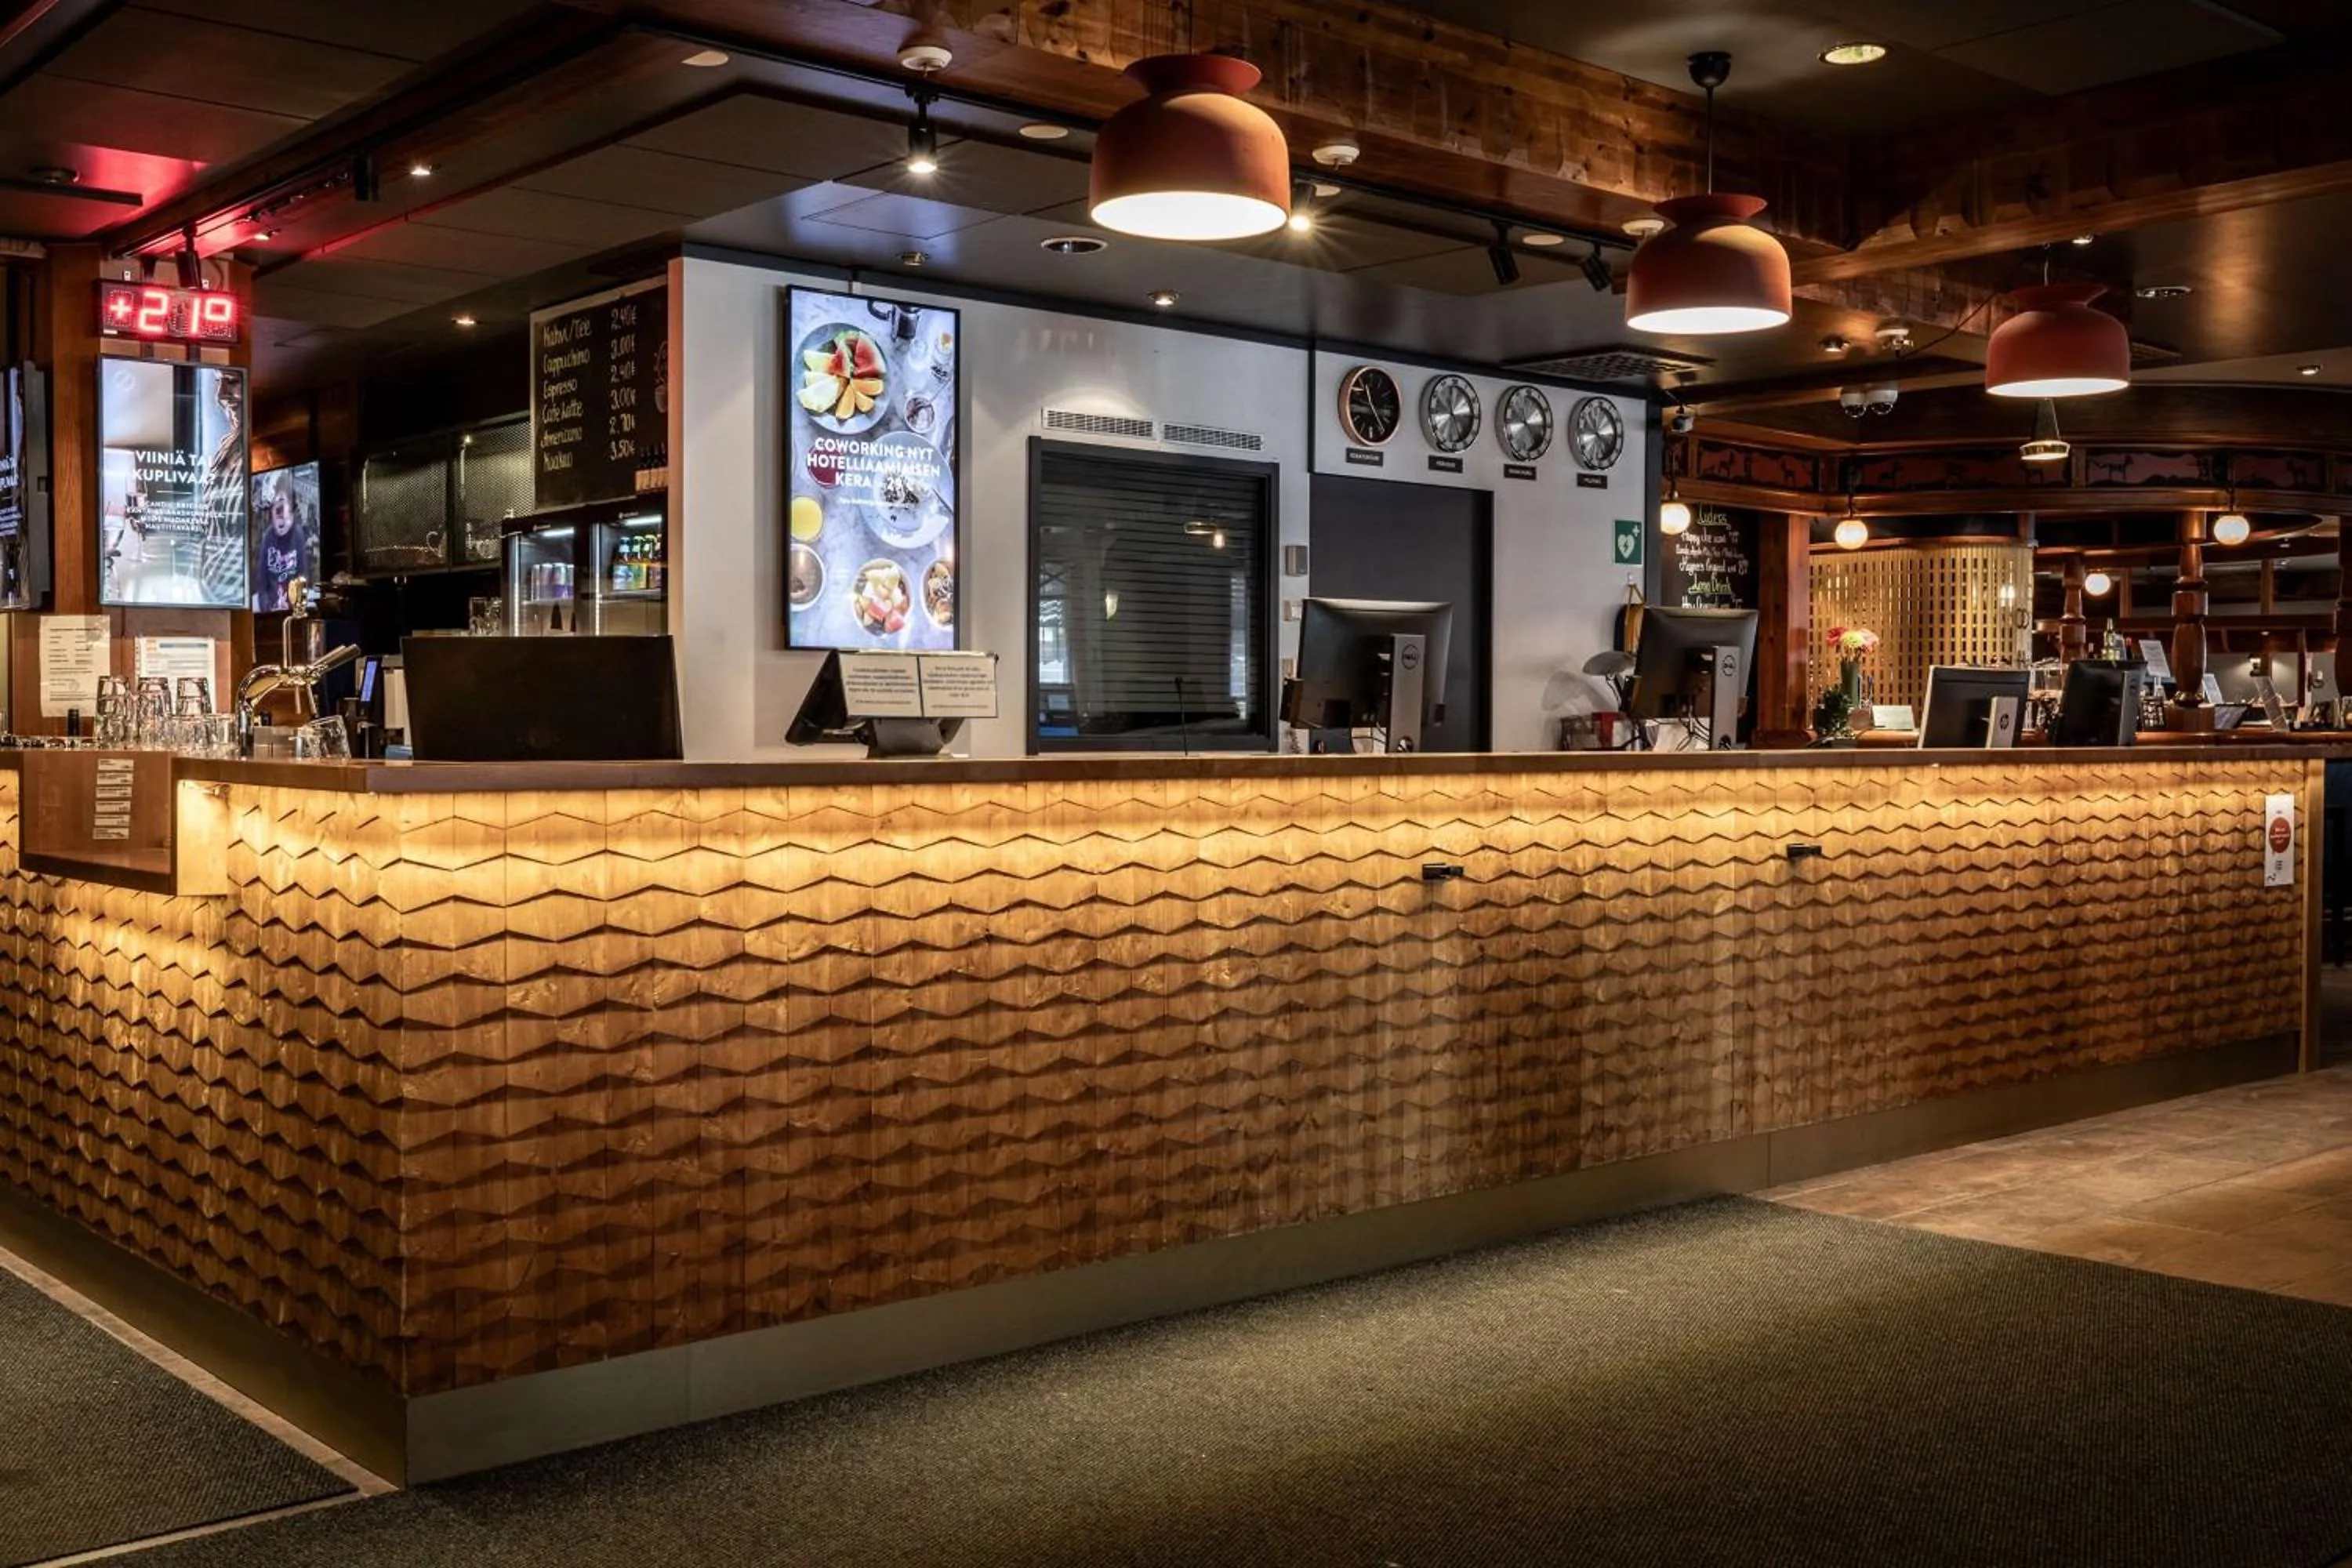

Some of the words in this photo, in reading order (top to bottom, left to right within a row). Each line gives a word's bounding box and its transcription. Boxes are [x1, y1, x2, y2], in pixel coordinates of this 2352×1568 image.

[815, 437, 907, 458] COWORKING
[907, 447, 934, 460] NYT
[135, 449, 187, 466] VIINIÄ
[835, 472, 873, 488] KERA
